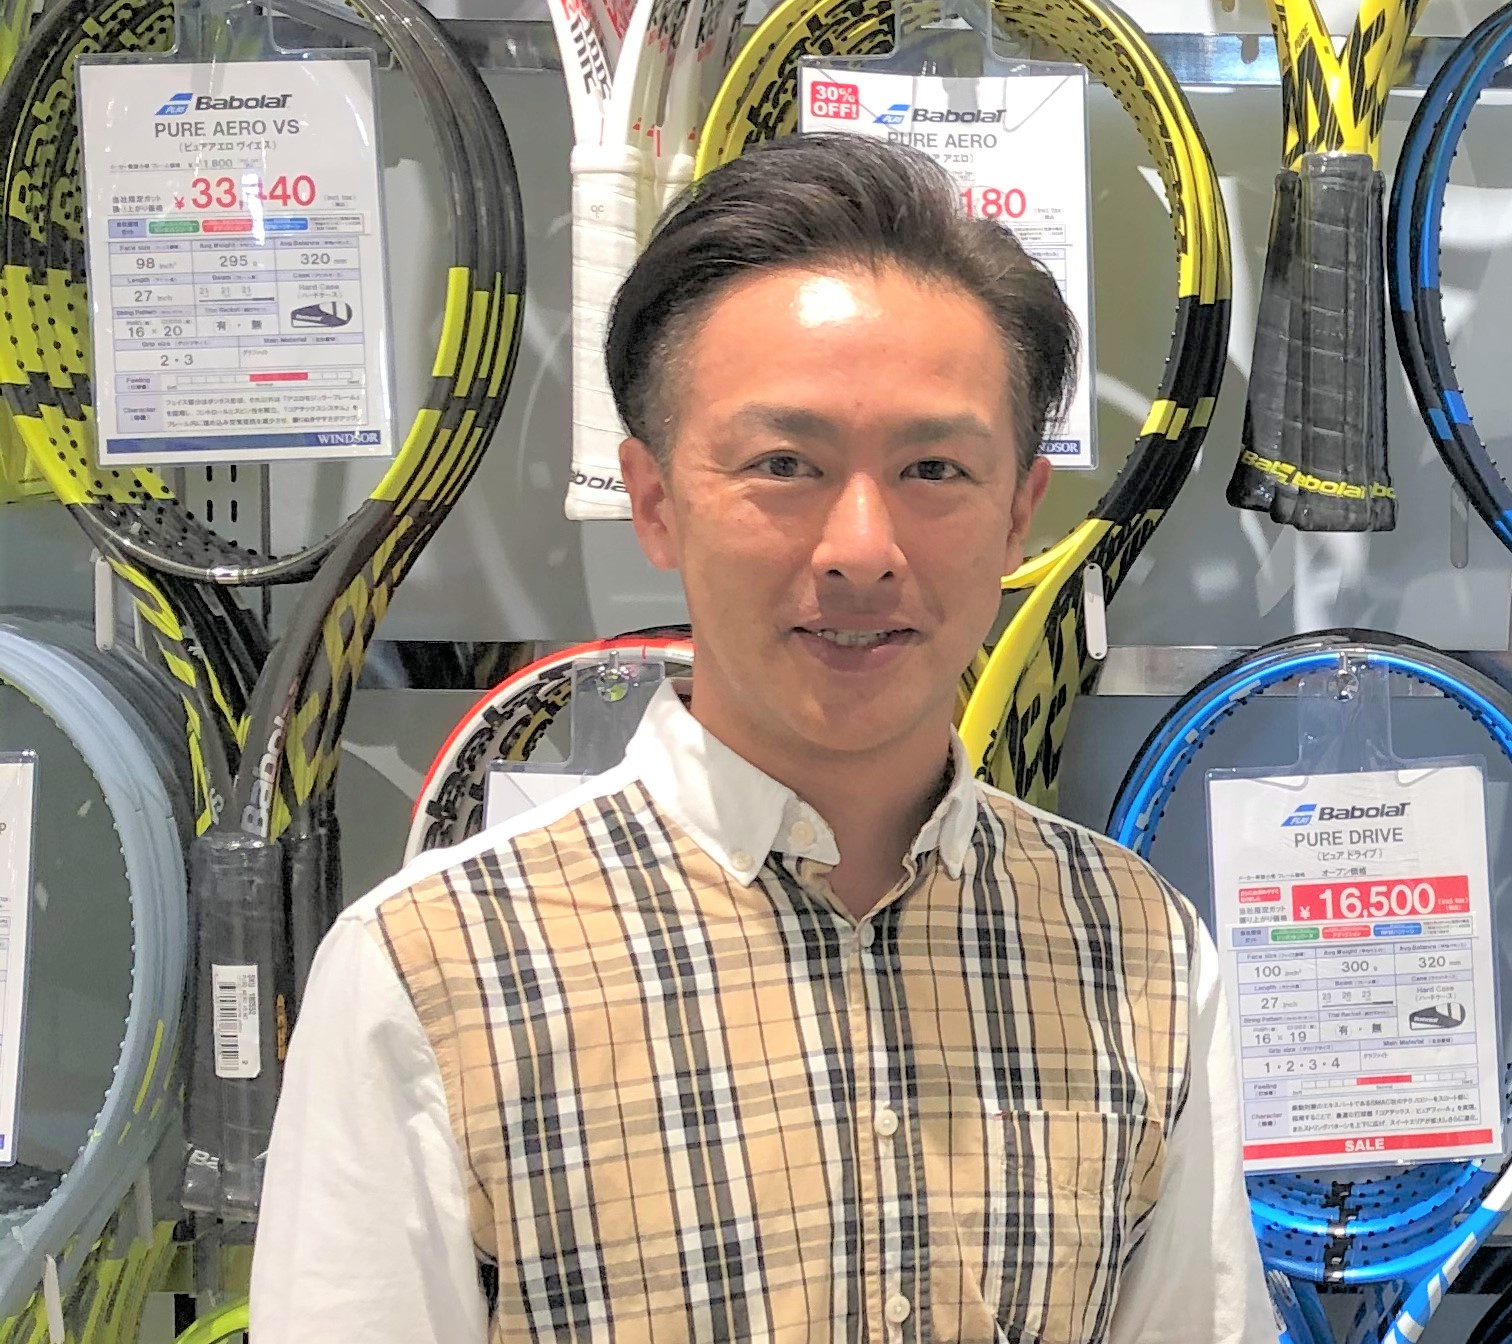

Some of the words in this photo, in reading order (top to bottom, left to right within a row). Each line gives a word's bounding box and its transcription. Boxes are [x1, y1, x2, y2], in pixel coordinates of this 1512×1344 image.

[816, 85, 856, 103] 30%
[814, 102, 857, 118] OFF!
[155, 122, 205, 138] PURE
[213, 120, 266, 136] AERO
[273, 119, 300, 134] VS
[888, 132, 938, 148] PURE
[945, 133, 997, 148] AERO
[174, 197, 185, 209] ¥
[192, 175, 316, 209] 33,40
[960, 188, 1026, 219] 180
[136, 258, 155, 269] 98
[219, 255, 248, 268] 295
[300, 253, 330, 265] 320
[134, 290, 152, 302] 27
[128, 327, 144, 338] 16
[164, 326, 182, 337] 20
[318, 433, 378, 444] WINDSOR
[1294, 831, 1343, 848] PURE
[1349, 828, 1403, 845] DRIVE
[1300, 906, 1310, 919] ¥
[1319, 883, 1435, 920] 16,500
[1342, 960, 1369, 972] 300
[1418, 956, 1446, 968] 320
[1254, 965, 1281, 977] 100
[1261, 998, 1278, 1009] 27
[1255, 1033, 1271, 1045] 16
[1289, 1032, 1306, 1043] 19
[1345, 1138, 1385, 1152] SALE
